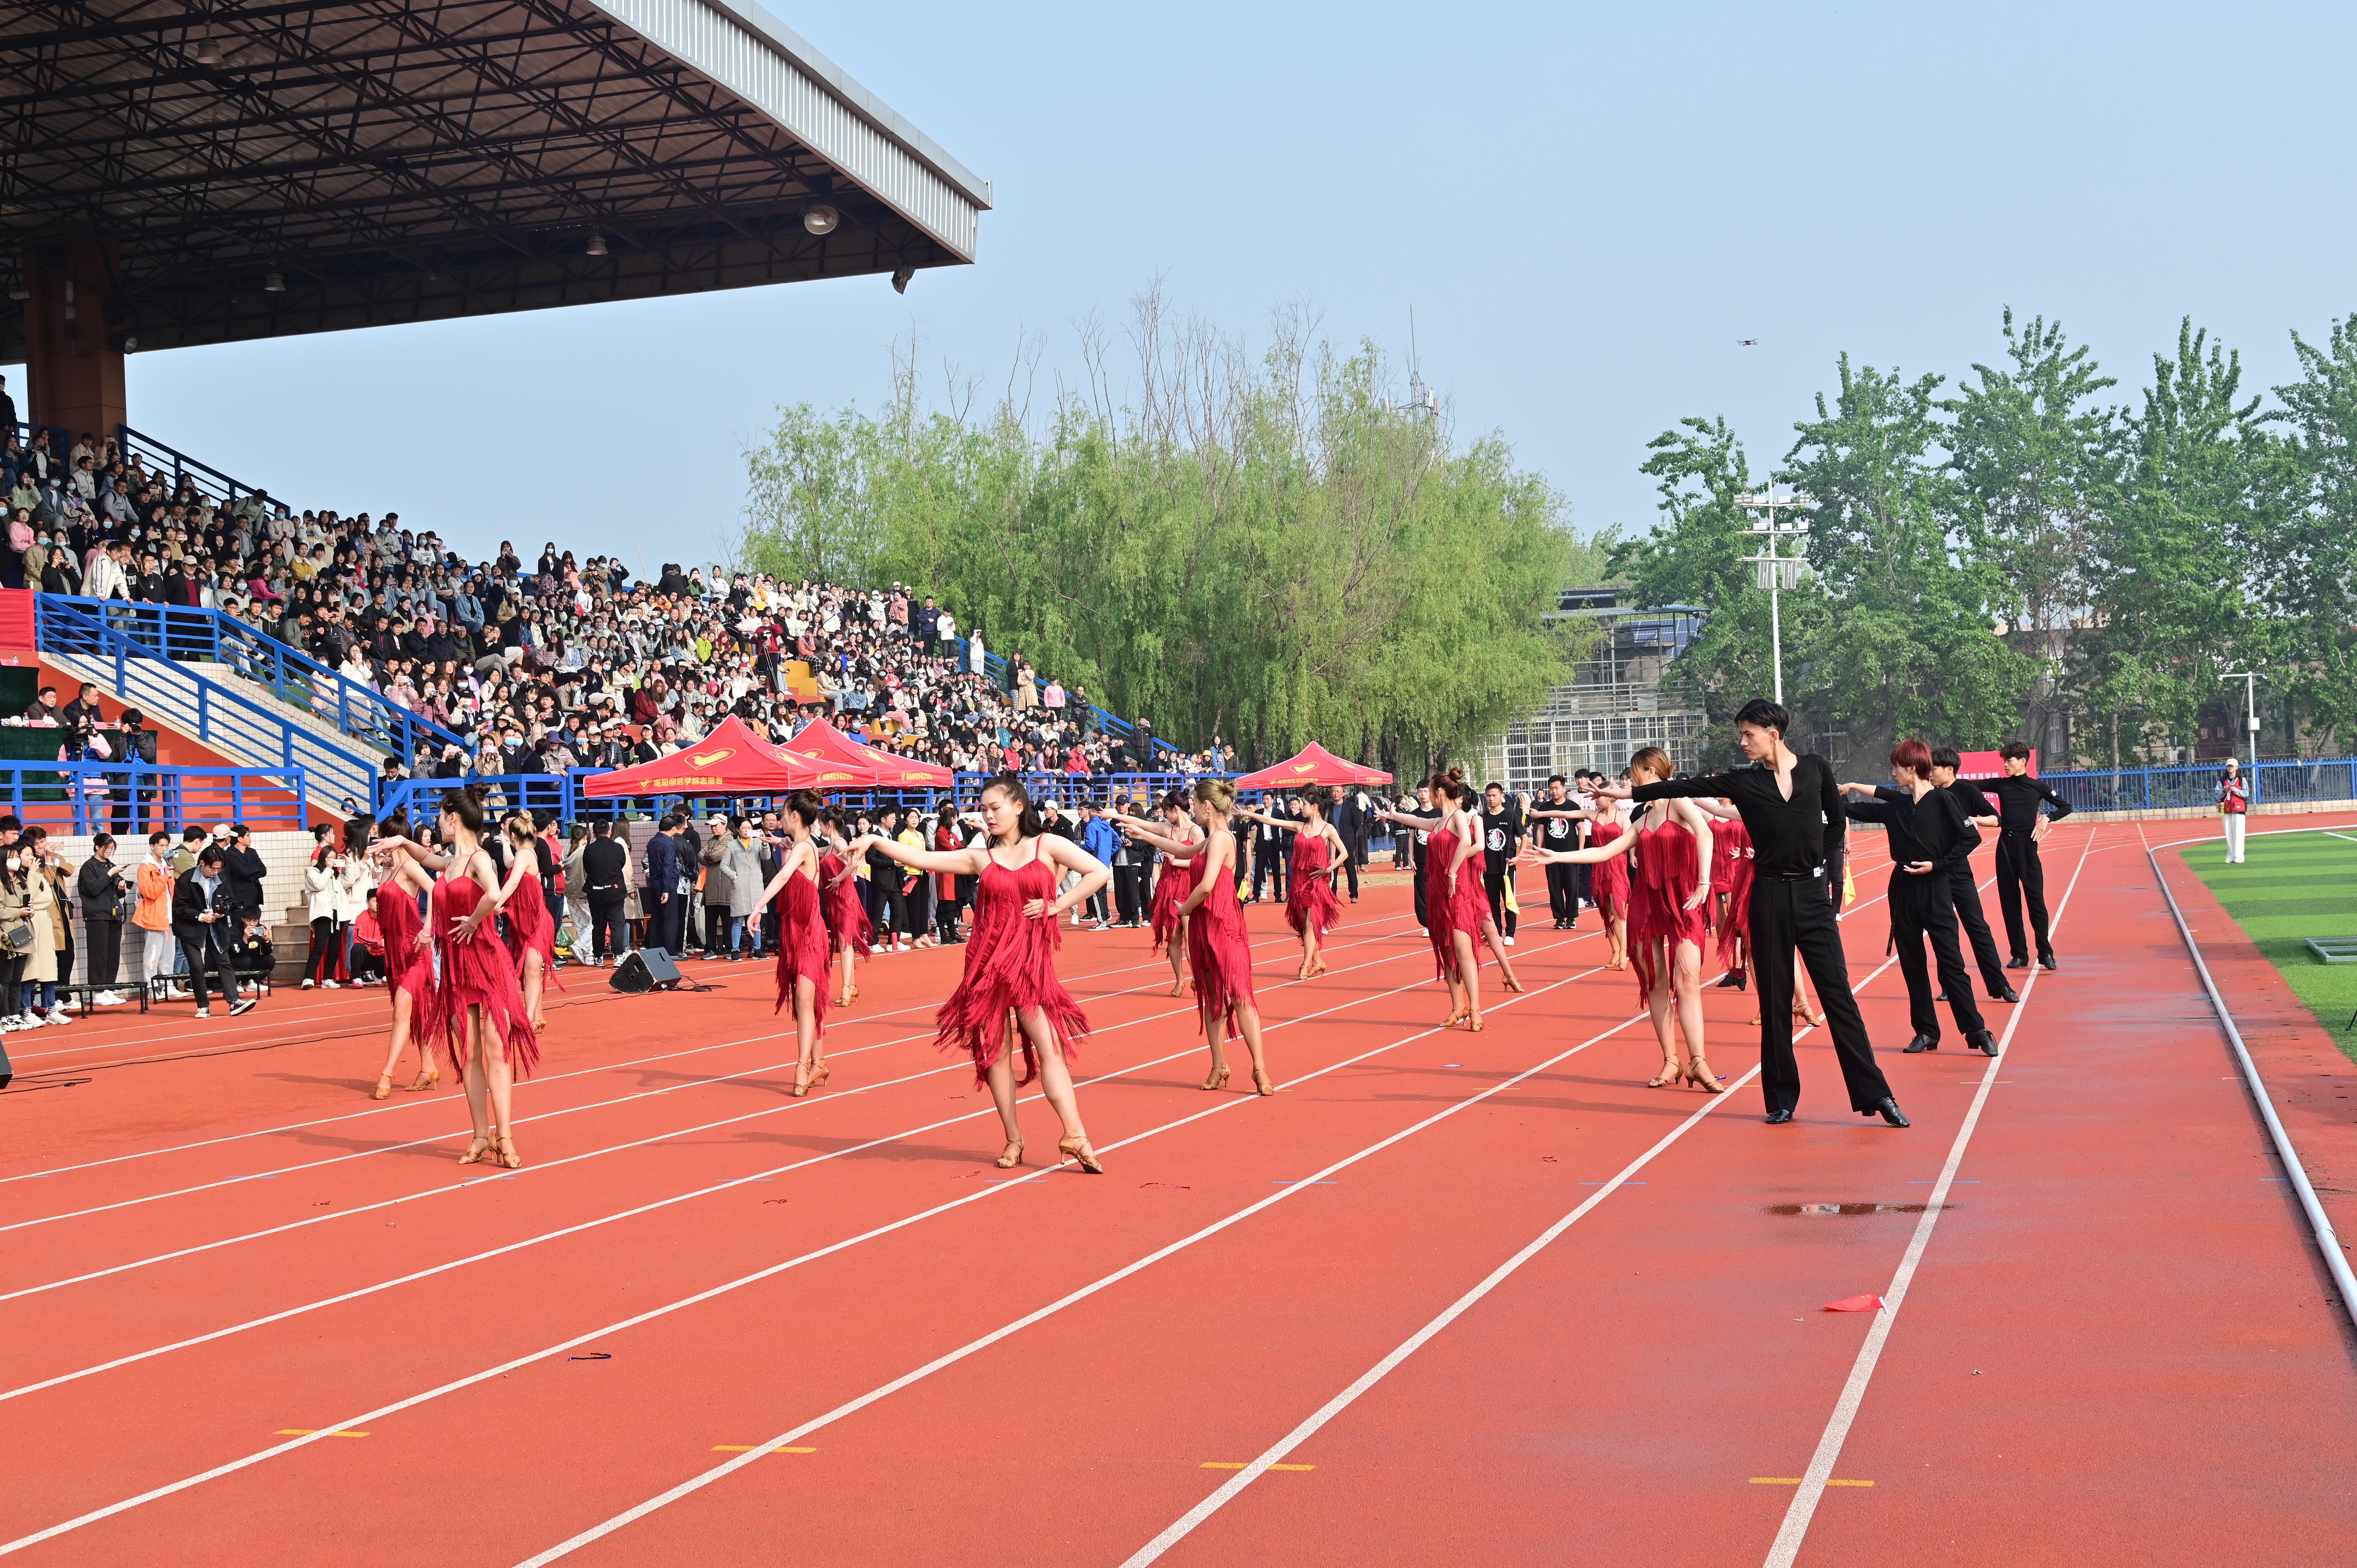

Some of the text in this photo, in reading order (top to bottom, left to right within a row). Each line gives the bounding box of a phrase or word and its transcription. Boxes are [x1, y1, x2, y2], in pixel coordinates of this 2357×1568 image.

[654, 777, 723, 787] 南阳师范学院志愿者
